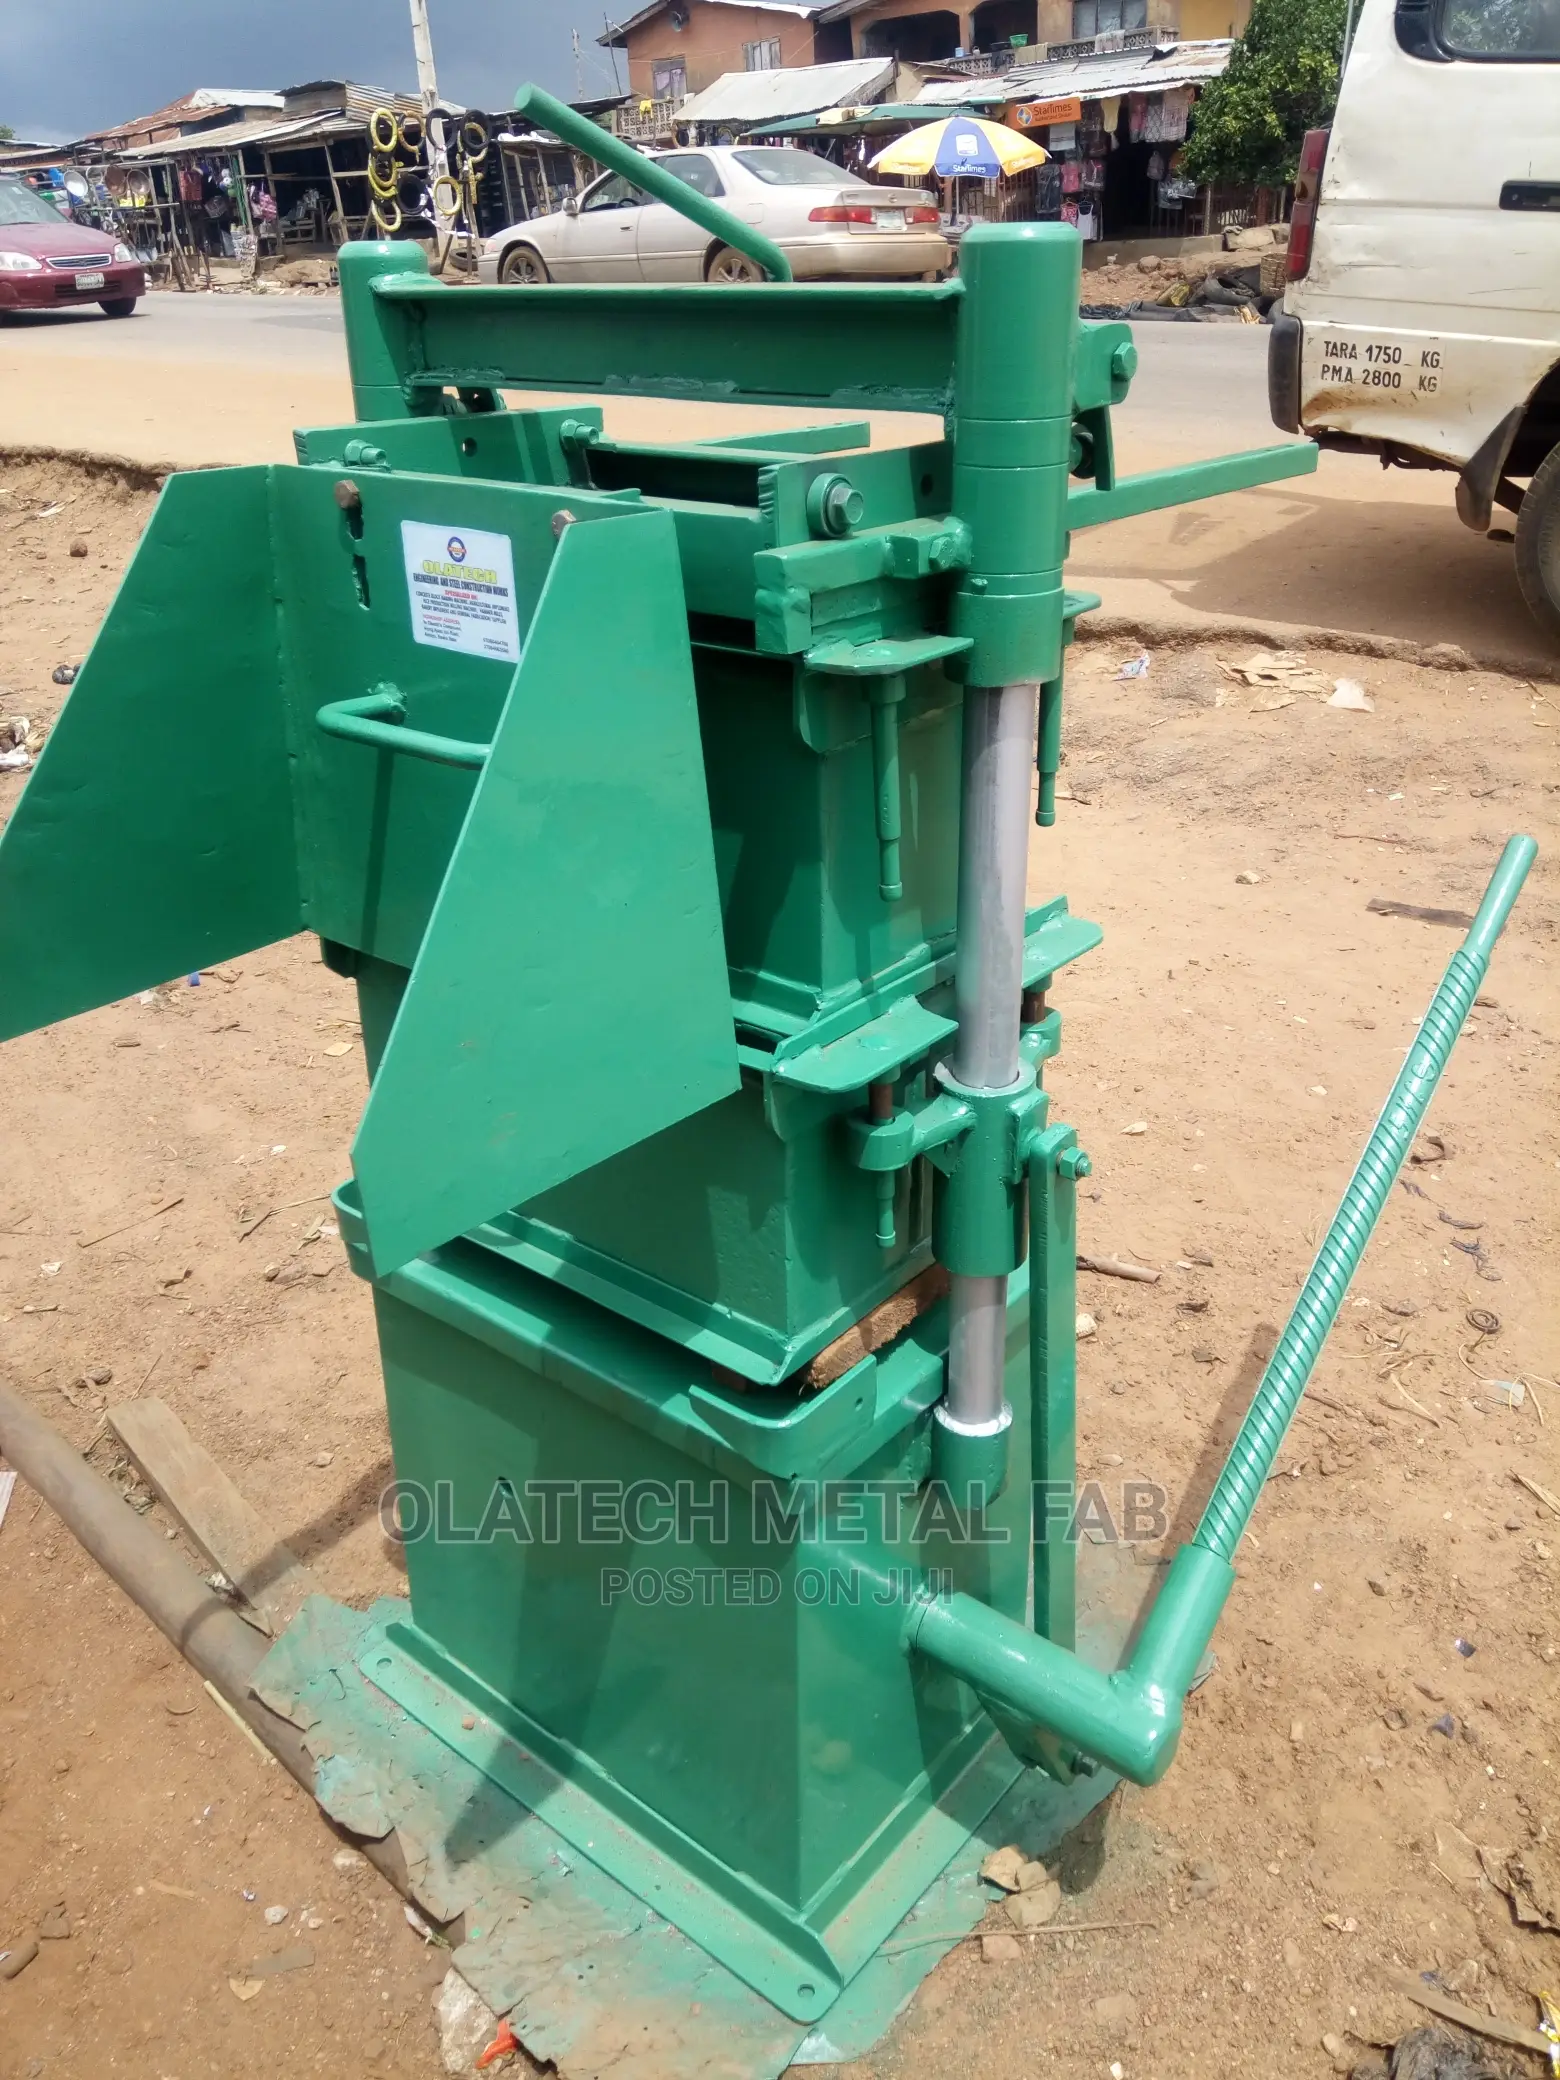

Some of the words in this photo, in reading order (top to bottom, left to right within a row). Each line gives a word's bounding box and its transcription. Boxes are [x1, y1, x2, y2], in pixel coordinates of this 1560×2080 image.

[1033, 103, 1072, 116] StarTimes
[952, 164, 986, 174] StarTimes
[1324, 340, 1357, 360] TARA
[1365, 344, 1402, 364] 1750
[1420, 350, 1440, 369] KG
[1362, 369, 1401, 388] 2800
[1418, 375, 1437, 392] KG
